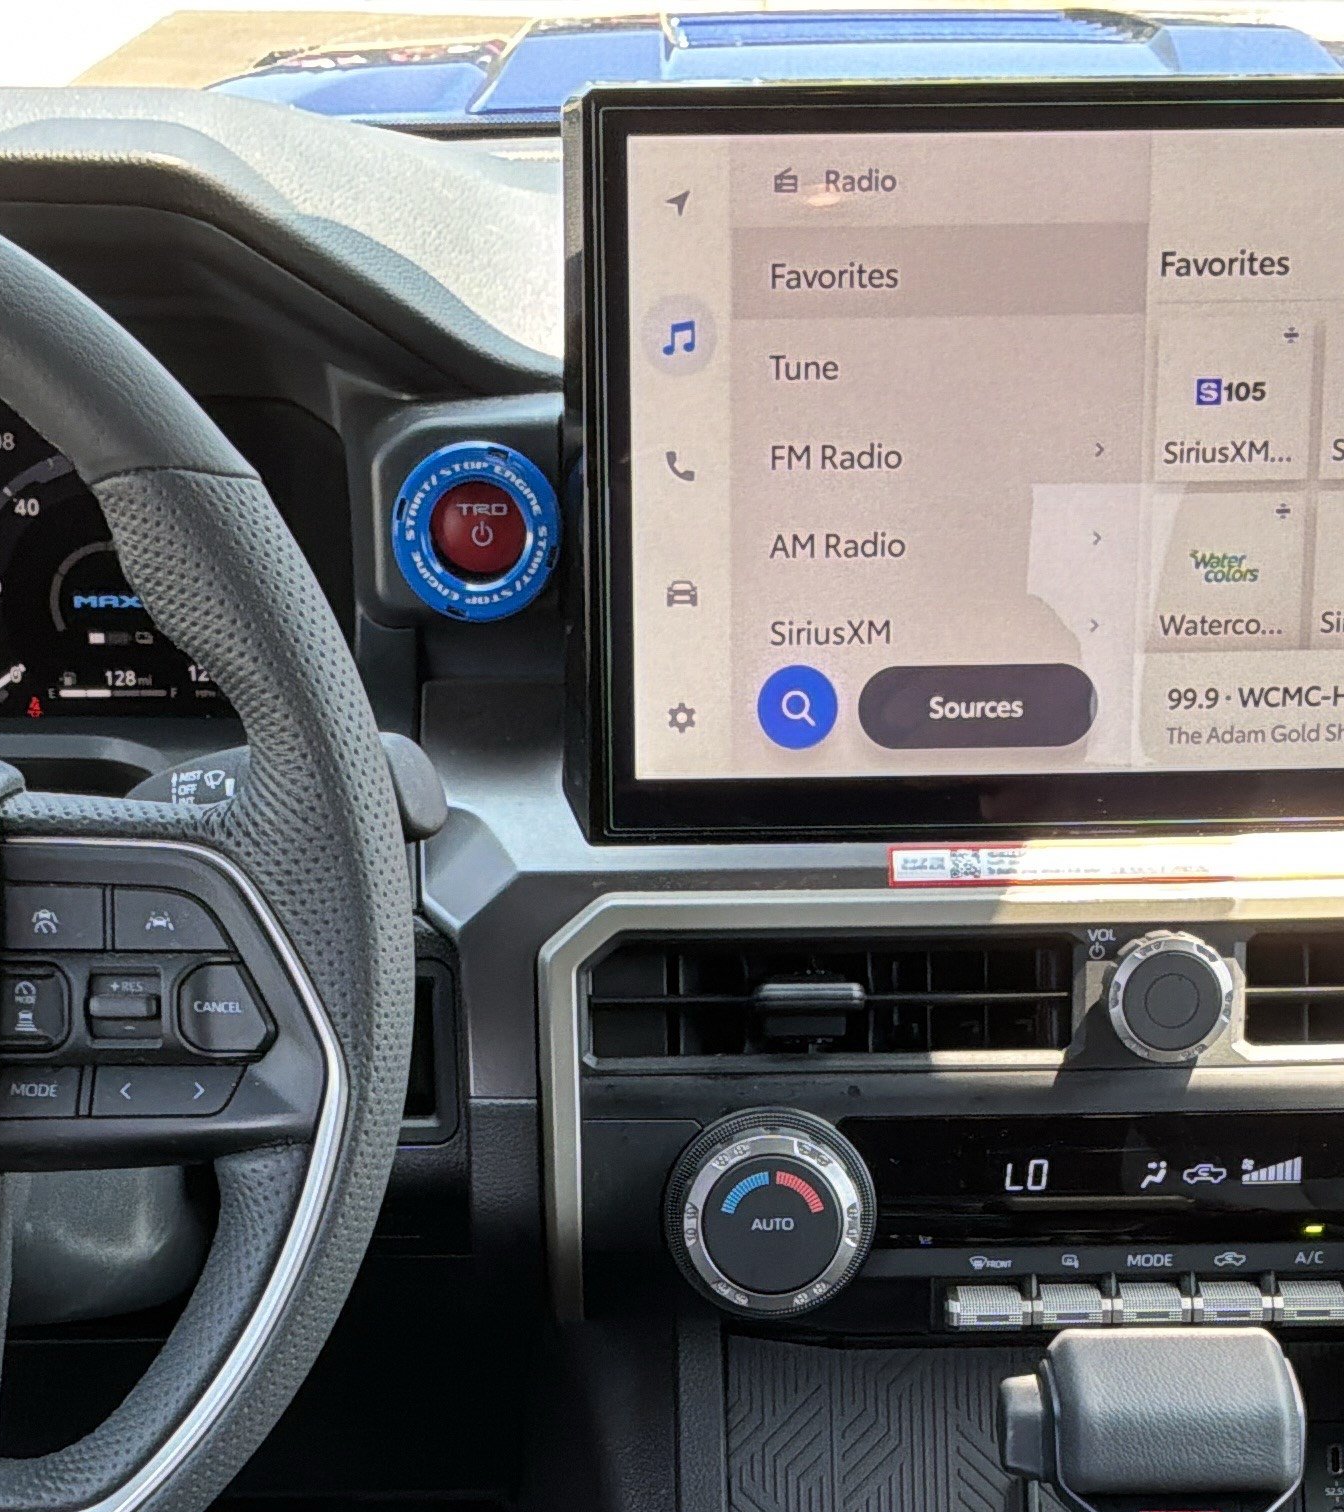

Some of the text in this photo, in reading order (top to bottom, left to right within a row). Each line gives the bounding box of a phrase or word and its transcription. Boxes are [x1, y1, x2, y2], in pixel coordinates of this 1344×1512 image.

[824, 168, 898, 194] Radio
[1160, 249, 1291, 278] Favorites
[770, 262, 900, 291] Favorites
[769, 354, 840, 382] Tune
[770, 442, 903, 471] FM Radio
[14, 498, 40, 517] 40
[456, 502, 508, 516] TRD
[768, 530, 906, 560] AM Radio
[1190, 549, 1247, 572] Water
[1204, 565, 1259, 584] colors
[72, 594, 144, 609] MAX
[770, 618, 892, 646] SiriusXM
[105, 670, 137, 687] 128
[928, 695, 1024, 720] Sources
[1167, 686, 1220, 710] 99.9
[1166, 725, 1203, 745] The
[1207, 724, 1267, 745] Adam
[1271, 723, 1321, 744] Gold
[1087, 928, 1117, 942] VOL
[193, 1000, 242, 1014] CANCEL
[10, 1082, 59, 1099] MODE
[1004, 1157, 1049, 1192] LO
[750, 1217, 795, 1231] AUTO
[986, 1257, 1013, 1270] FRONT
[1126, 1252, 1174, 1269] MODE
[1294, 1250, 1325, 1267] A/C
